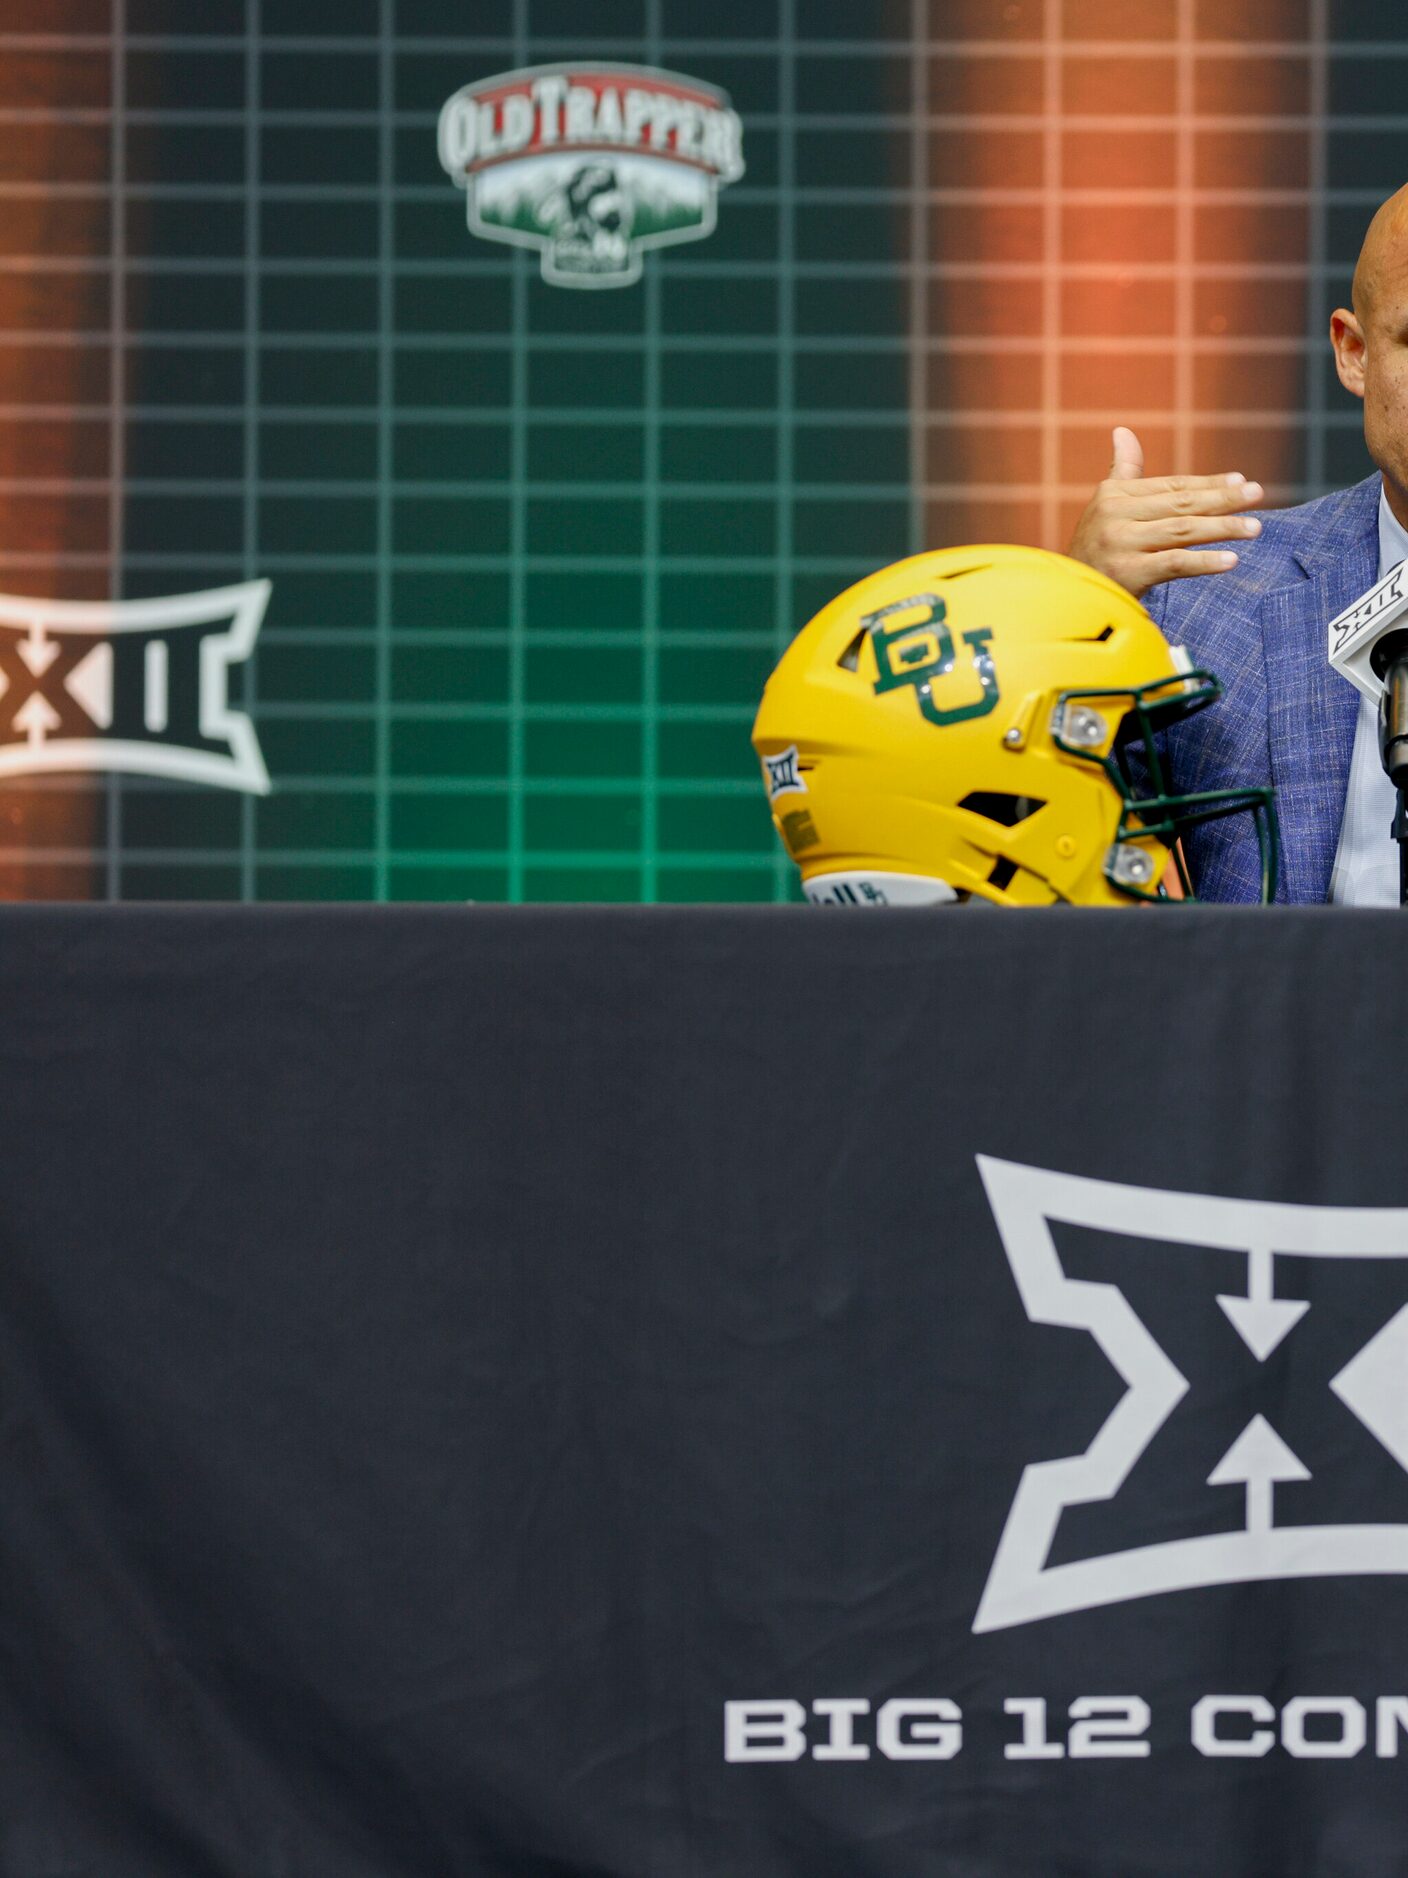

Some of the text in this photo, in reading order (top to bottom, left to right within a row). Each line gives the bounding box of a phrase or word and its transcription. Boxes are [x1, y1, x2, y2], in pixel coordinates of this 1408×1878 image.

[444, 75, 745, 181] OLD TRAPPER
[861, 592, 1001, 727] BU
[724, 1698, 963, 1763] BIG
[1004, 1696, 1151, 1760] 12
